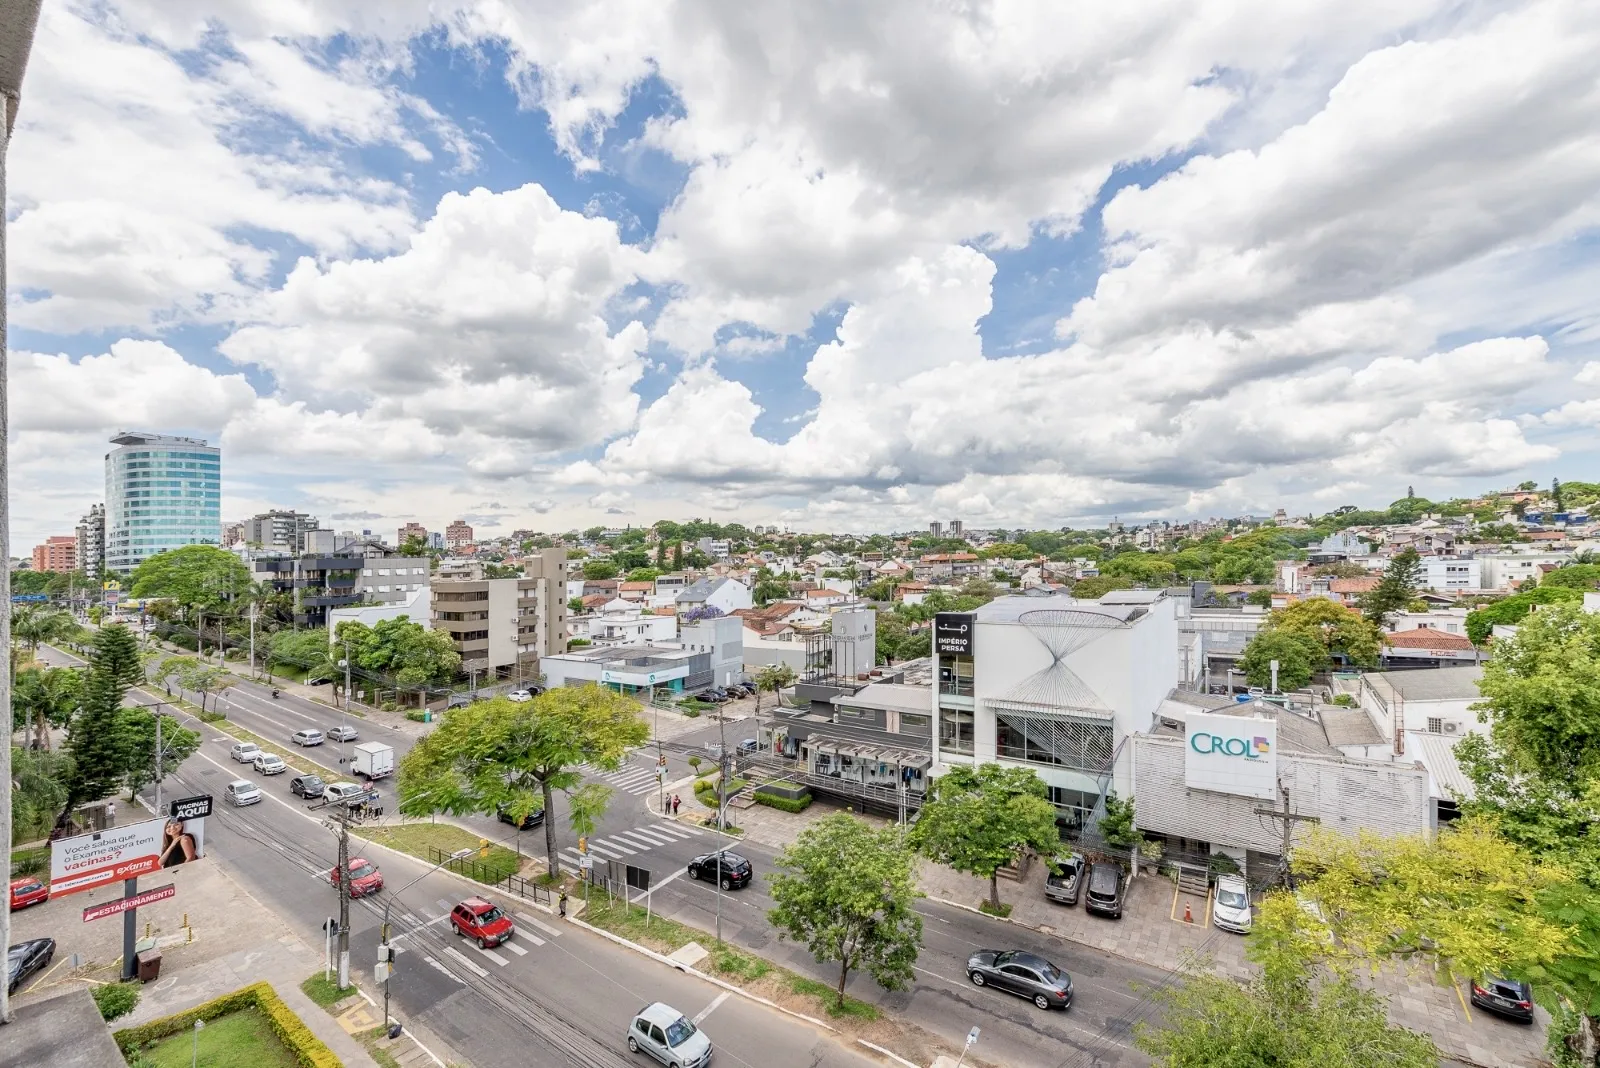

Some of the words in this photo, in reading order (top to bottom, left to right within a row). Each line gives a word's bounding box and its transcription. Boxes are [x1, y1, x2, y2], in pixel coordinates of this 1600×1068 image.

[938, 637, 968, 645] IMPÉRIO
[1190, 732, 1260, 758] CROL
[176, 800, 209, 810] VACINAS
[176, 806, 209, 818] AQUI!
[64, 844, 90, 855] Você
[92, 839, 117, 849] sabia
[118, 833, 136, 844] que
[72, 847, 107, 861] Exame
[108, 842, 134, 854] agora
[136, 836, 154, 846] tem
[63, 854, 114, 871] vacinas
[98, 888, 174, 916] ESTACIONAMENTO
